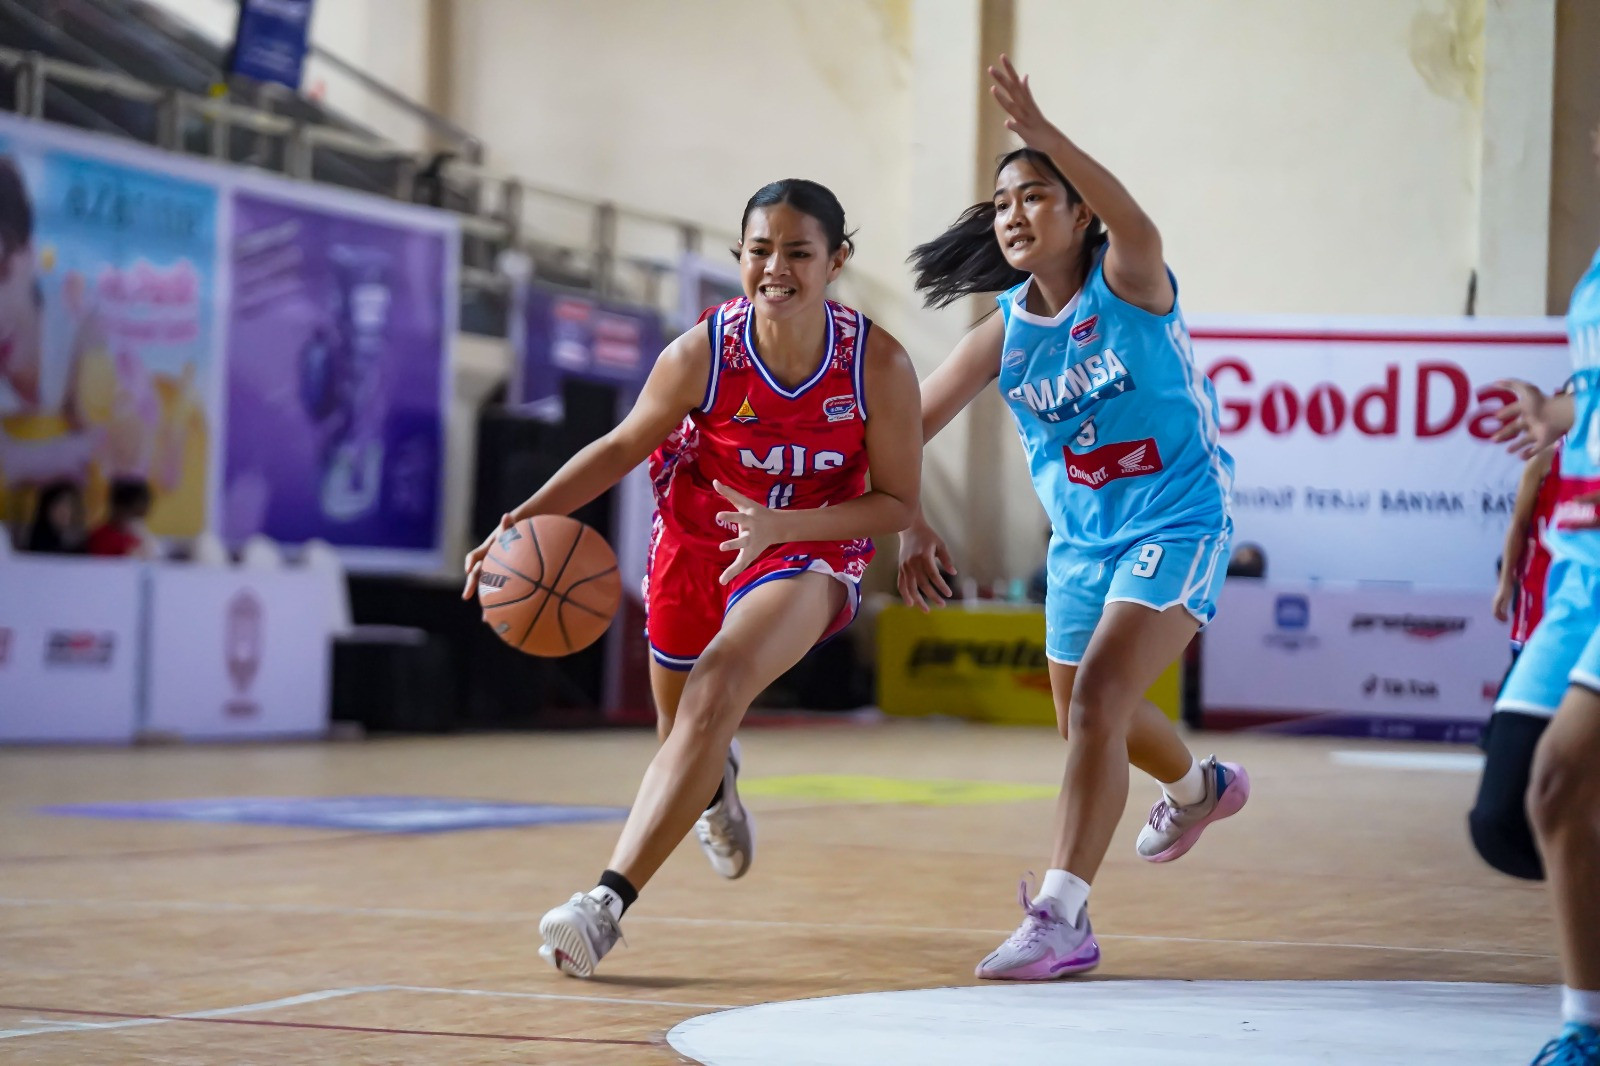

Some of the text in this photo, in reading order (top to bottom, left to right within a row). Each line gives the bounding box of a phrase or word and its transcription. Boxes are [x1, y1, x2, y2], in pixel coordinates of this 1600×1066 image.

[1205, 357, 1524, 441] Good Da
[1121, 464, 1155, 474] HONDA
[1381, 488, 1465, 515] BANYAK
[1481, 490, 1518, 517] RAS
[1131, 543, 1165, 579] 9
